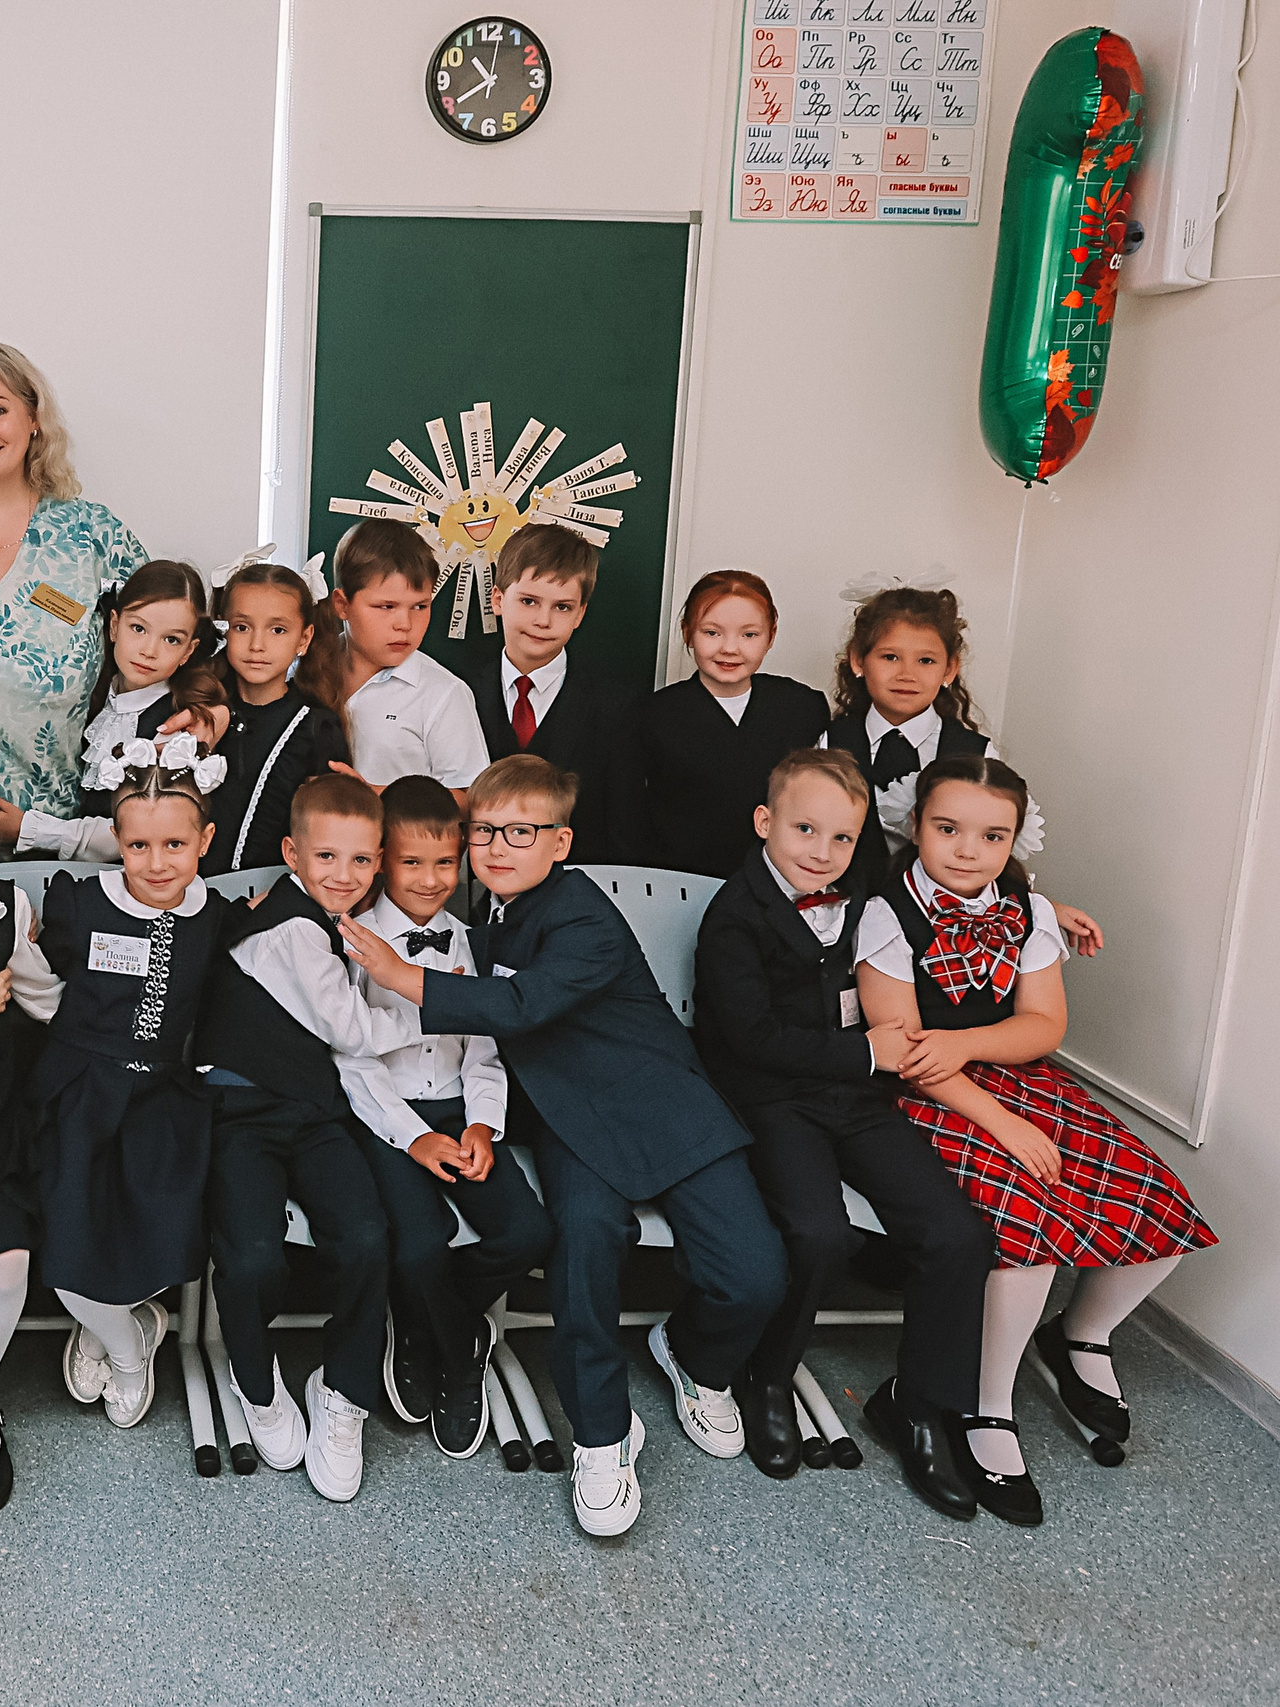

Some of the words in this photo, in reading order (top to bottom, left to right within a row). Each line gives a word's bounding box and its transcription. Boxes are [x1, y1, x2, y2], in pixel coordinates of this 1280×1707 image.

[477, 22, 503, 41] 12
[509, 28, 521, 45] 1
[756, 30, 773, 40] Оо
[802, 31, 819, 41] Пп
[849, 32, 865, 44] Рр
[895, 32, 912, 43] Сс
[942, 33, 955, 44] Тт
[441, 47, 463, 67] 10
[523, 45, 539, 65] 2
[758, 44, 783, 68] Оо
[803, 44, 835, 68] Пп
[853, 45, 877, 76] Рр
[900, 47, 922, 70] Сс
[938, 48, 979, 71] Тт
[437, 71, 450, 90] 9
[529, 68, 545, 88] 3
[754, 79, 769, 91] Уу
[800, 79, 820, 92] Фф
[846, 80, 860, 90] Хх
[891, 81, 908, 93] Цц
[937, 82, 953, 92] Чч
[520, 94, 536, 114] 4
[759, 92, 782, 125] Уу
[803, 93, 832, 126] Фф
[843, 93, 880, 116] Хх
[895, 95, 922, 122] Цц
[943, 95, 964, 118] Чч
[458, 113, 474, 130] 7
[481, 118, 496, 136] 6
[502, 112, 517, 132] 5
[748, 128, 772, 138] Шш
[795, 128, 819, 140] Щщ
[746, 142, 784, 163] Шш
[792, 143, 831, 170] Щщ
[745, 174, 762, 186] Ээ
[791, 175, 815, 186] Юю
[837, 176, 854, 187] Яя
[889, 183, 926, 191] гласные
[929, 182, 958, 193] буквы
[749, 188, 773, 211] Ээ
[789, 188, 828, 211] Юю
[840, 188, 867, 213] Яя
[883, 206, 930, 215] согласные
[933, 206, 961, 216] буквы
[483, 428, 493, 463] Ника
[441, 442, 457, 479] Саша
[504, 446, 529, 476] Вова
[526, 445, 551, 474] Ваня
[397, 450, 444, 500] Кристина
[563, 466, 595, 486] Ваня
[390, 480, 430, 506] Марта
[570, 483, 617, 500] Таисия
[358, 503, 387, 518] Глеб
[564, 506, 595, 522] Лиза
[456, 562, 473, 602] Миша
[106, 950, 139, 963] Полина
